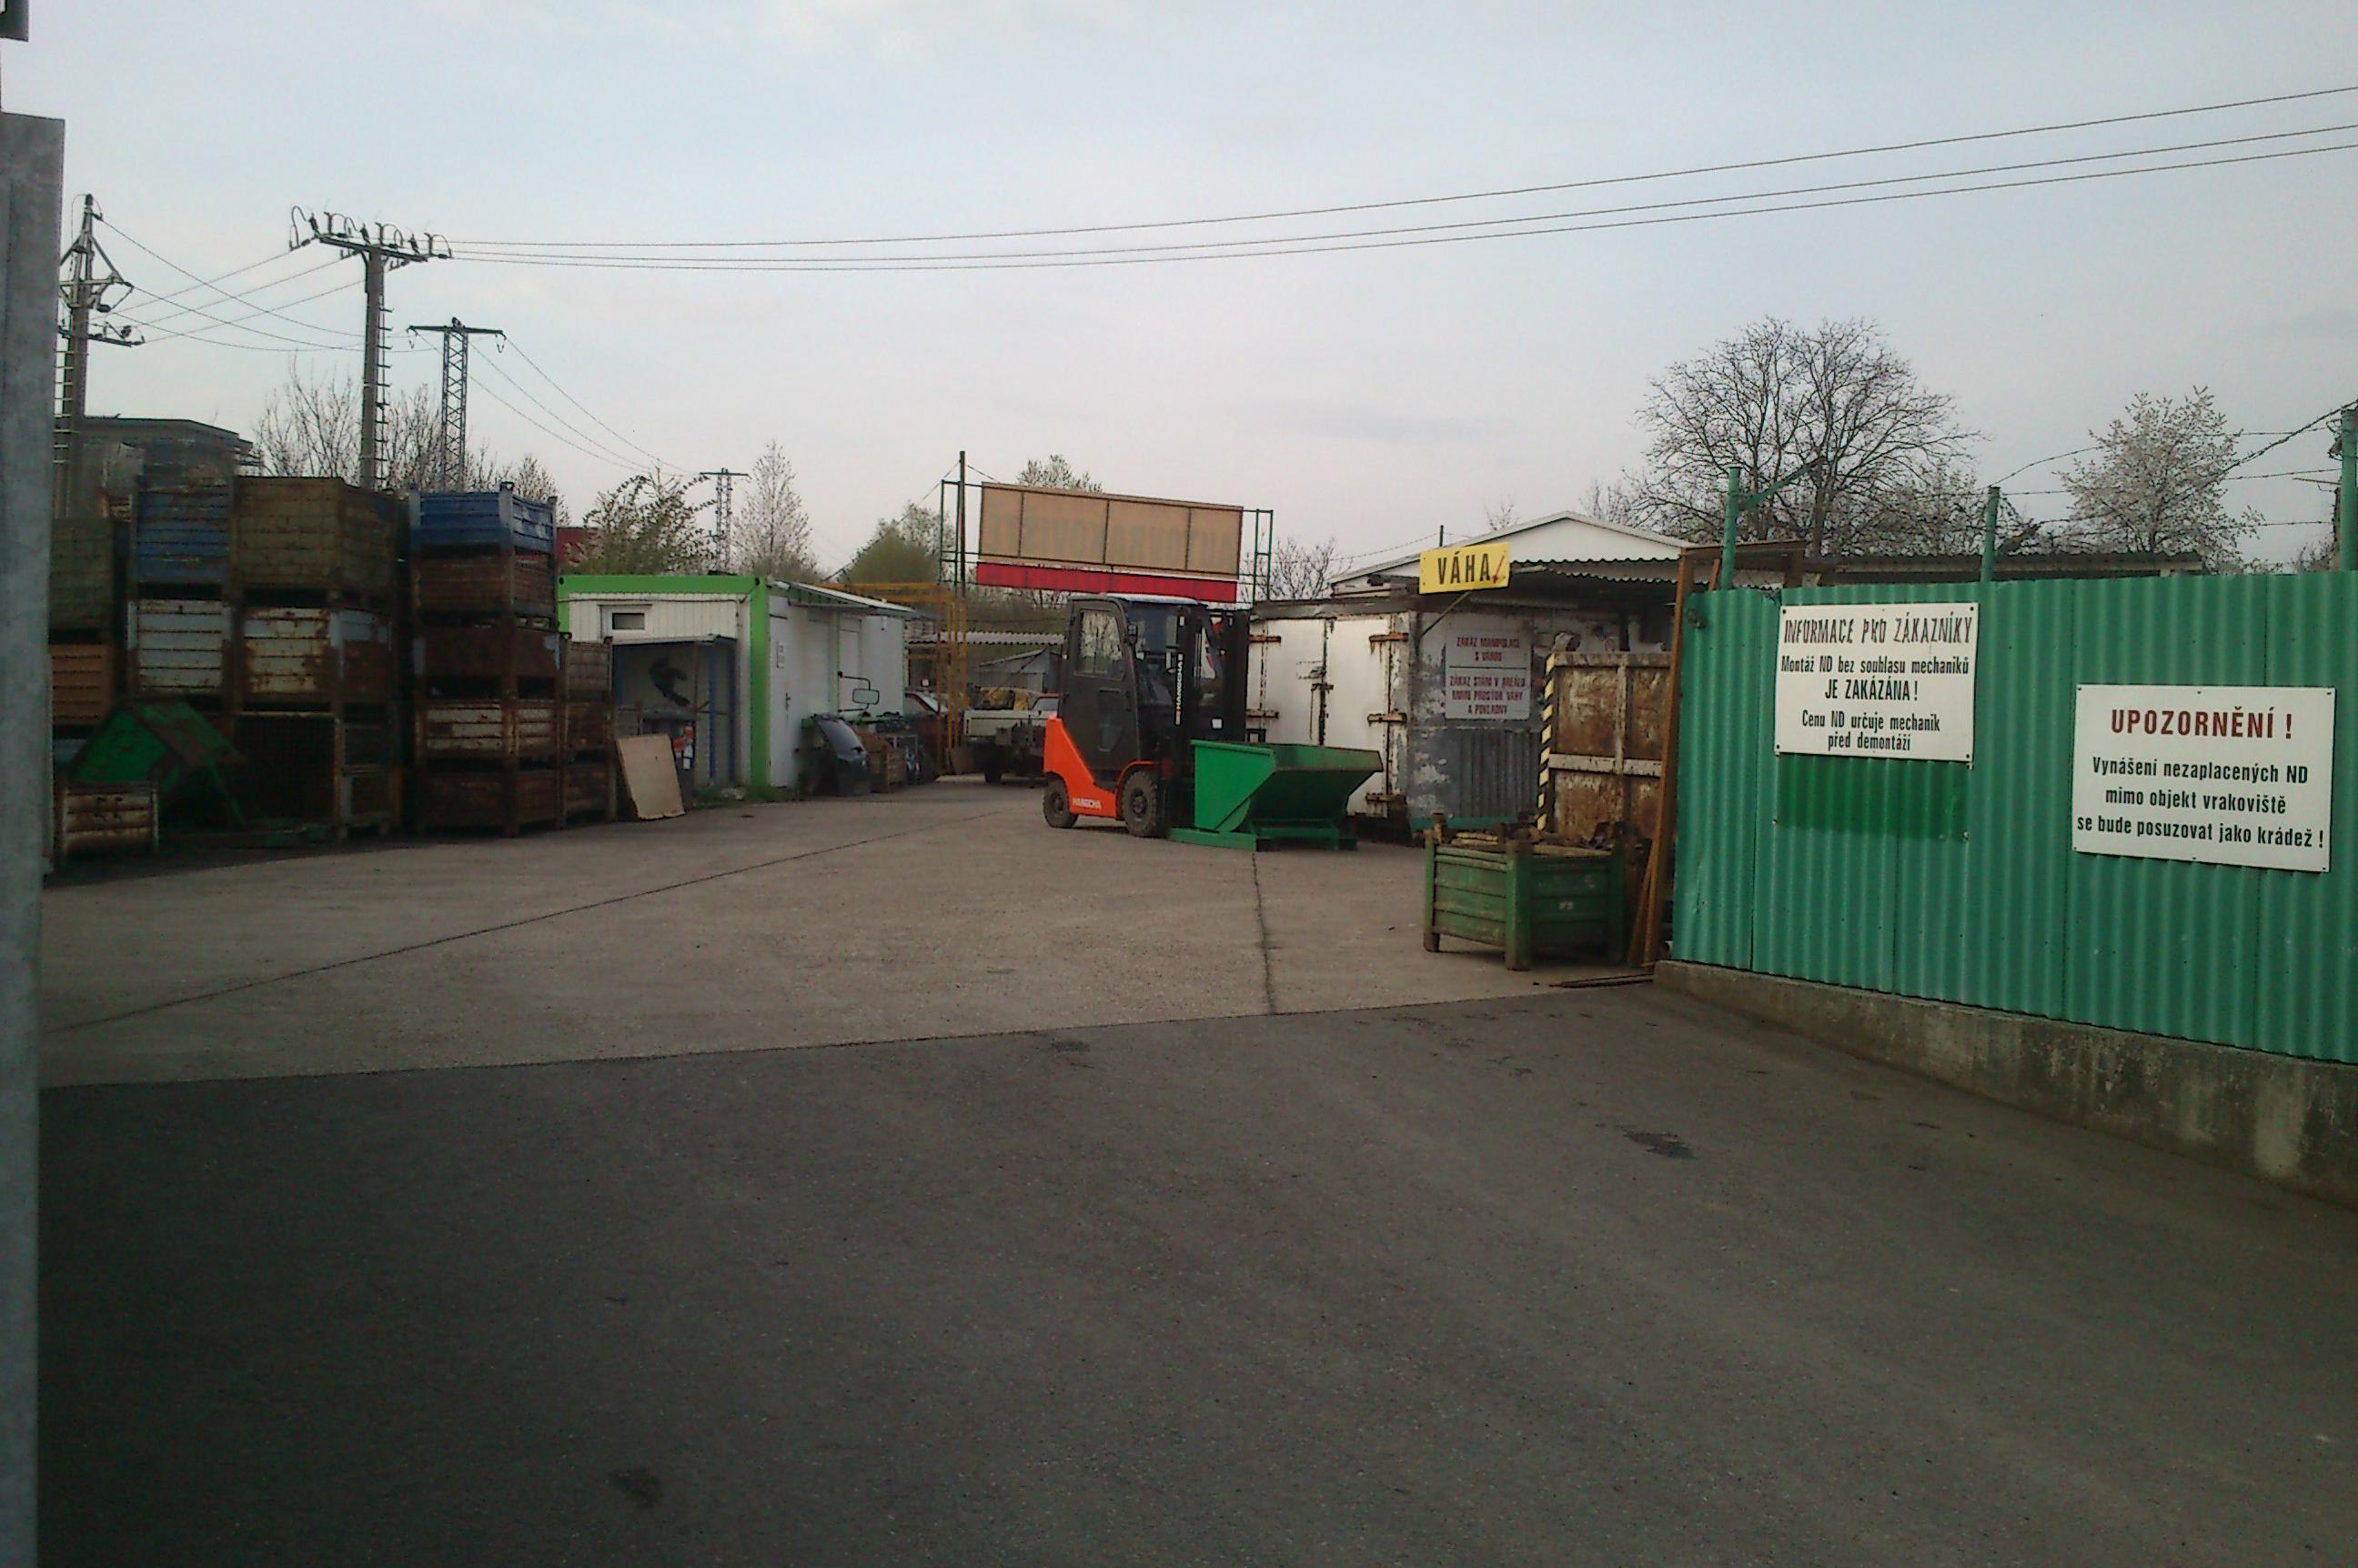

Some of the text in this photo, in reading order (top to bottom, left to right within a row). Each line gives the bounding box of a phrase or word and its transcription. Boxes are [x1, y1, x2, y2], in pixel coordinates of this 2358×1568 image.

[1437, 551, 1490, 585] VÁHA
[1784, 611, 1972, 644] INFORMACE PRO ZÁKAZNÍKY
[1781, 655, 1969, 675] Montáž ND bez souhlasu mechaniků
[1825, 678, 1838, 699] JE
[1802, 709, 1940, 733] Cenu ND určuje mechanik
[2111, 706, 2274, 739] UPOZORNĚNÍ
[1828, 731, 1911, 751] před demontáží
[2092, 757, 2309, 784] Vynášení nezaplacených ND
[2105, 789, 2286, 815] mimo objekt vrakoviště
[2077, 816, 2092, 831] se
[2098, 815, 2131, 834] bude
[2137, 819, 2212, 841] posuzovat
[2219, 823, 2252, 844] jako
[2257, 826, 2313, 848] krádež
